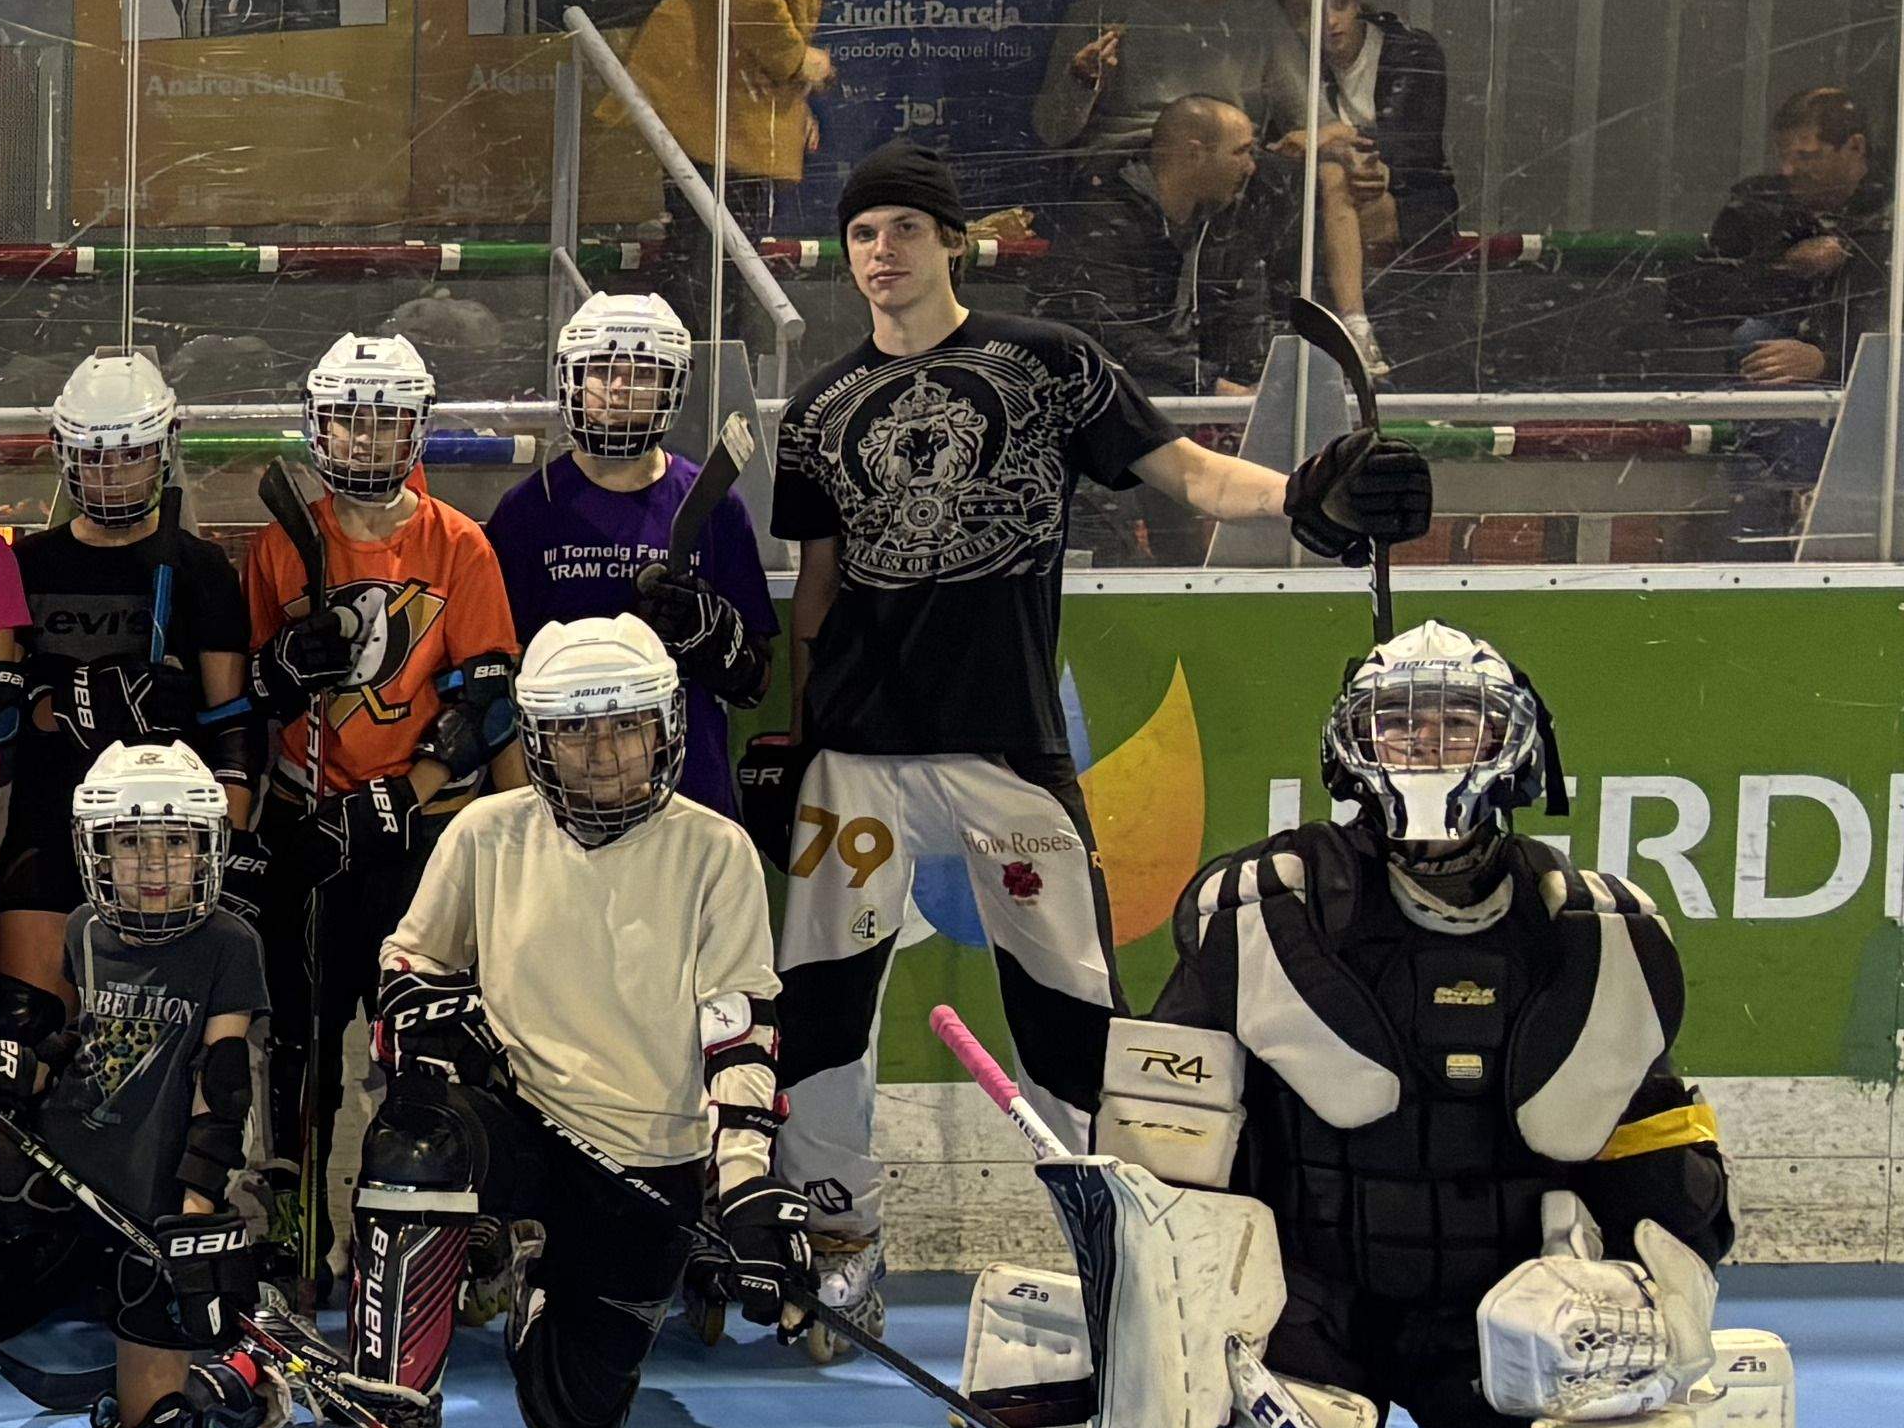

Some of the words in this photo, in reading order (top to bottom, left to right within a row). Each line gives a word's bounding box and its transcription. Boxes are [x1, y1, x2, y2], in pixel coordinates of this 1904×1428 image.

[829, 42, 904, 61] ugadora
[561, 544, 631, 561] Torneig
[548, 564, 601, 581] TRAM
[791, 804, 895, 889] 79
[1011, 831, 1073, 854] Roses
[1126, 1047, 1213, 1084] R4
[541, 1114, 625, 1176] TRUE
[310, 1377, 353, 1410] JUNIOR
